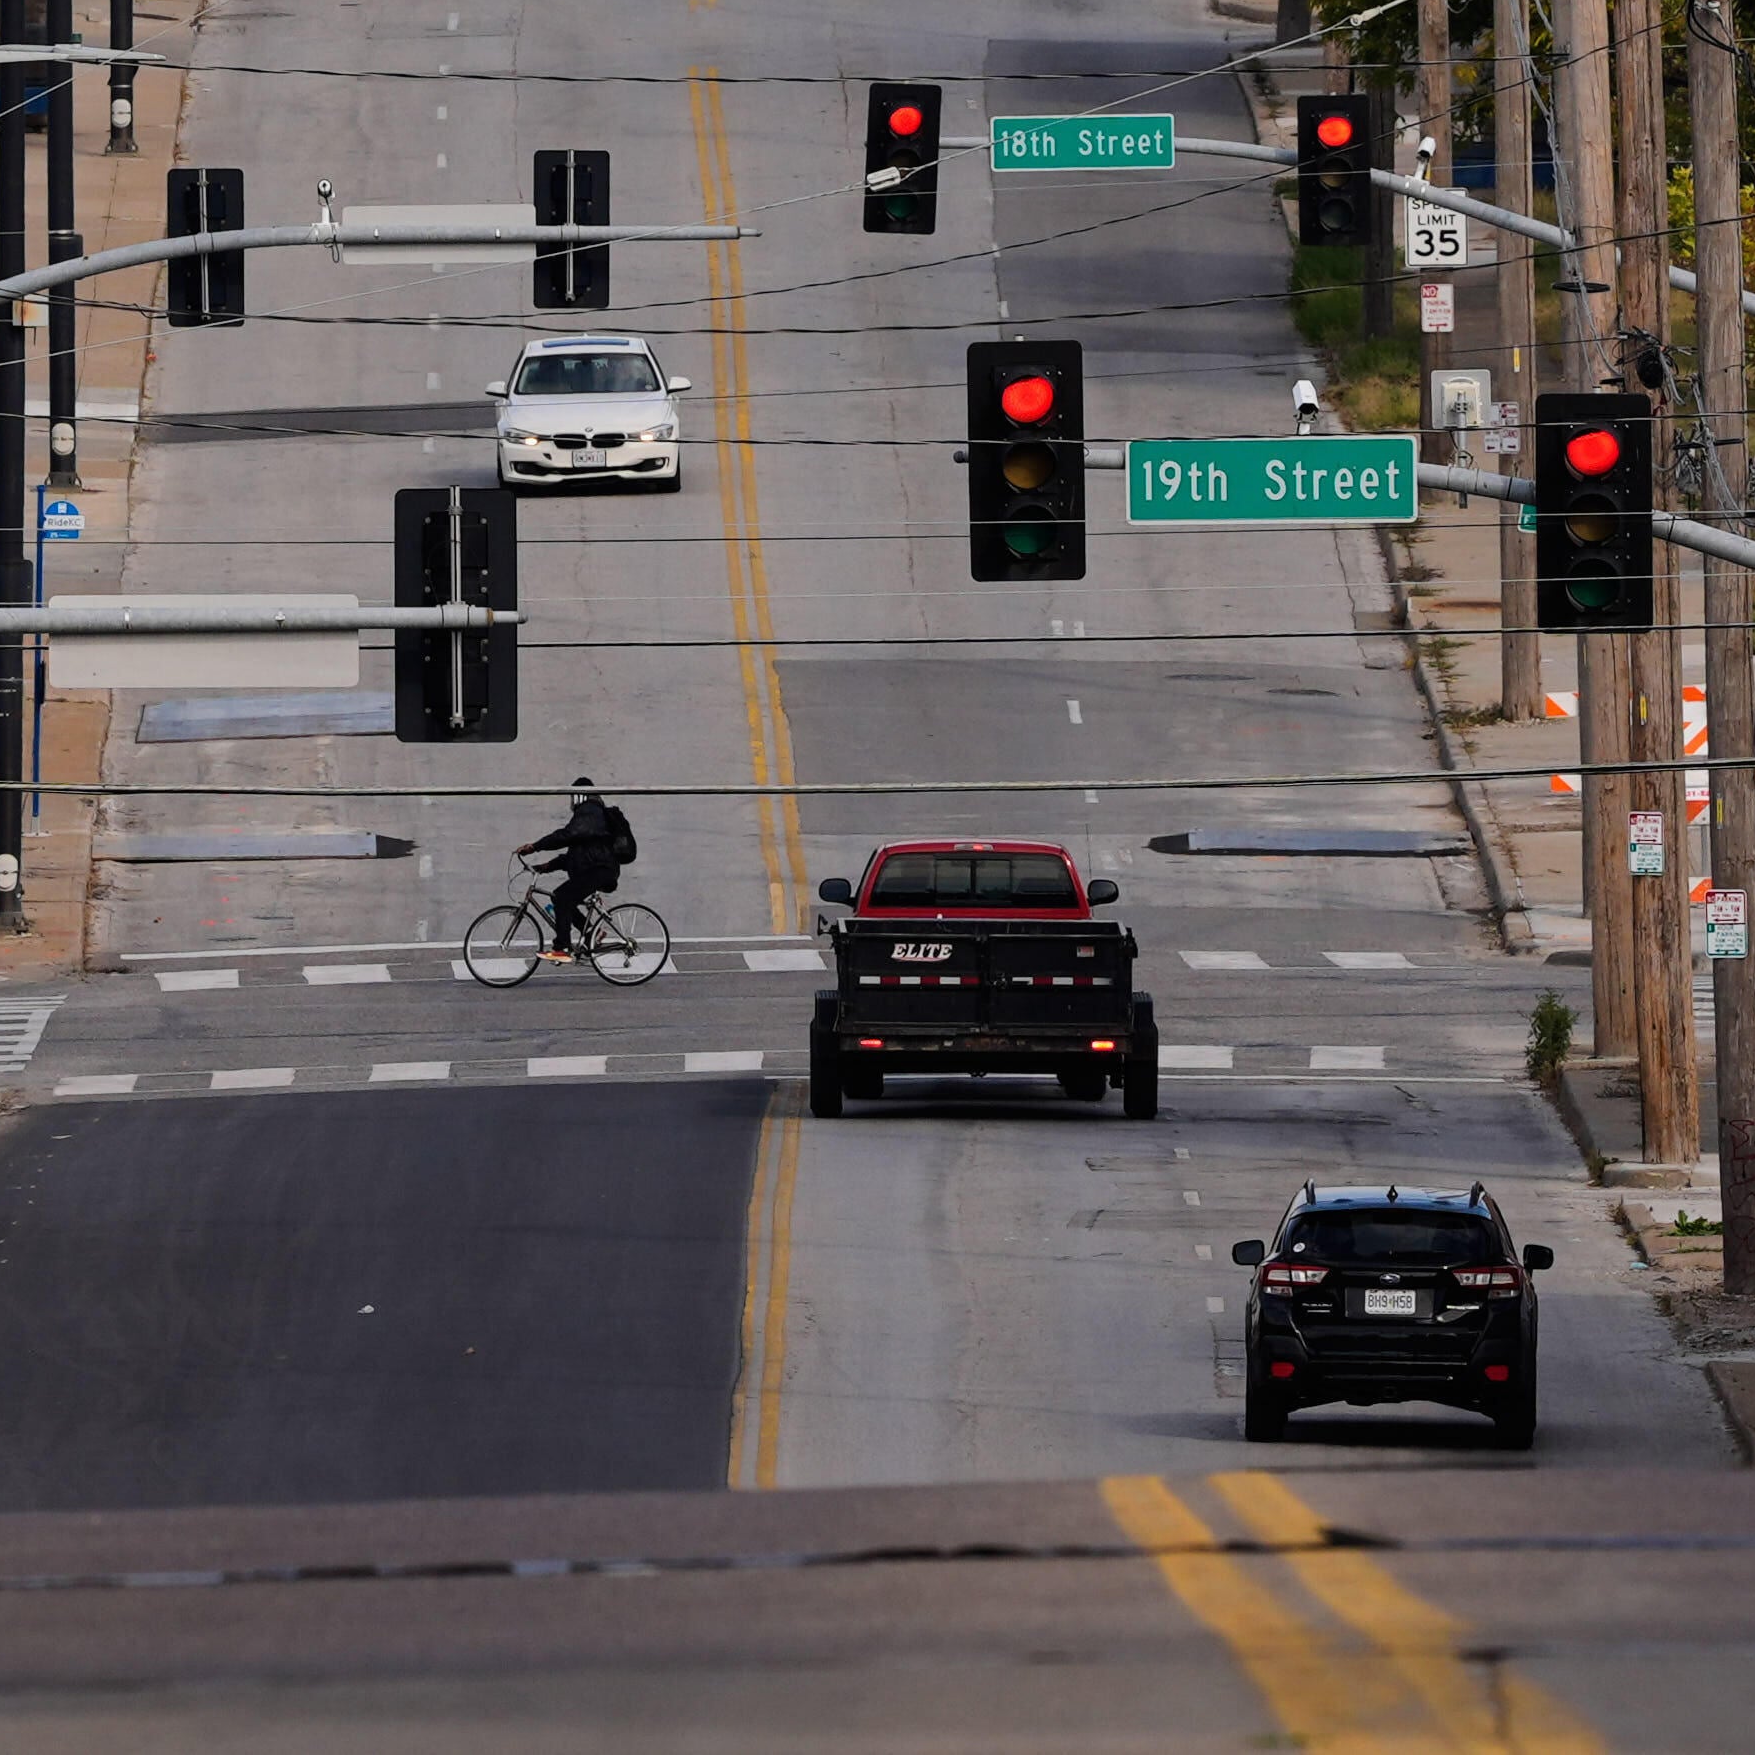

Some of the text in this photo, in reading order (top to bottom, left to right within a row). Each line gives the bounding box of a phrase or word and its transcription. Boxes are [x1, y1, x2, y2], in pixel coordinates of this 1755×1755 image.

[1001, 129, 1164, 157] 18th Street
[1417, 214, 1456, 226] LIMIT
[1414, 229, 1460, 257] 35
[1422, 287, 1437, 297] NO
[1143, 459, 1400, 502] 19th Street
[891, 943, 953, 960] ELITE
